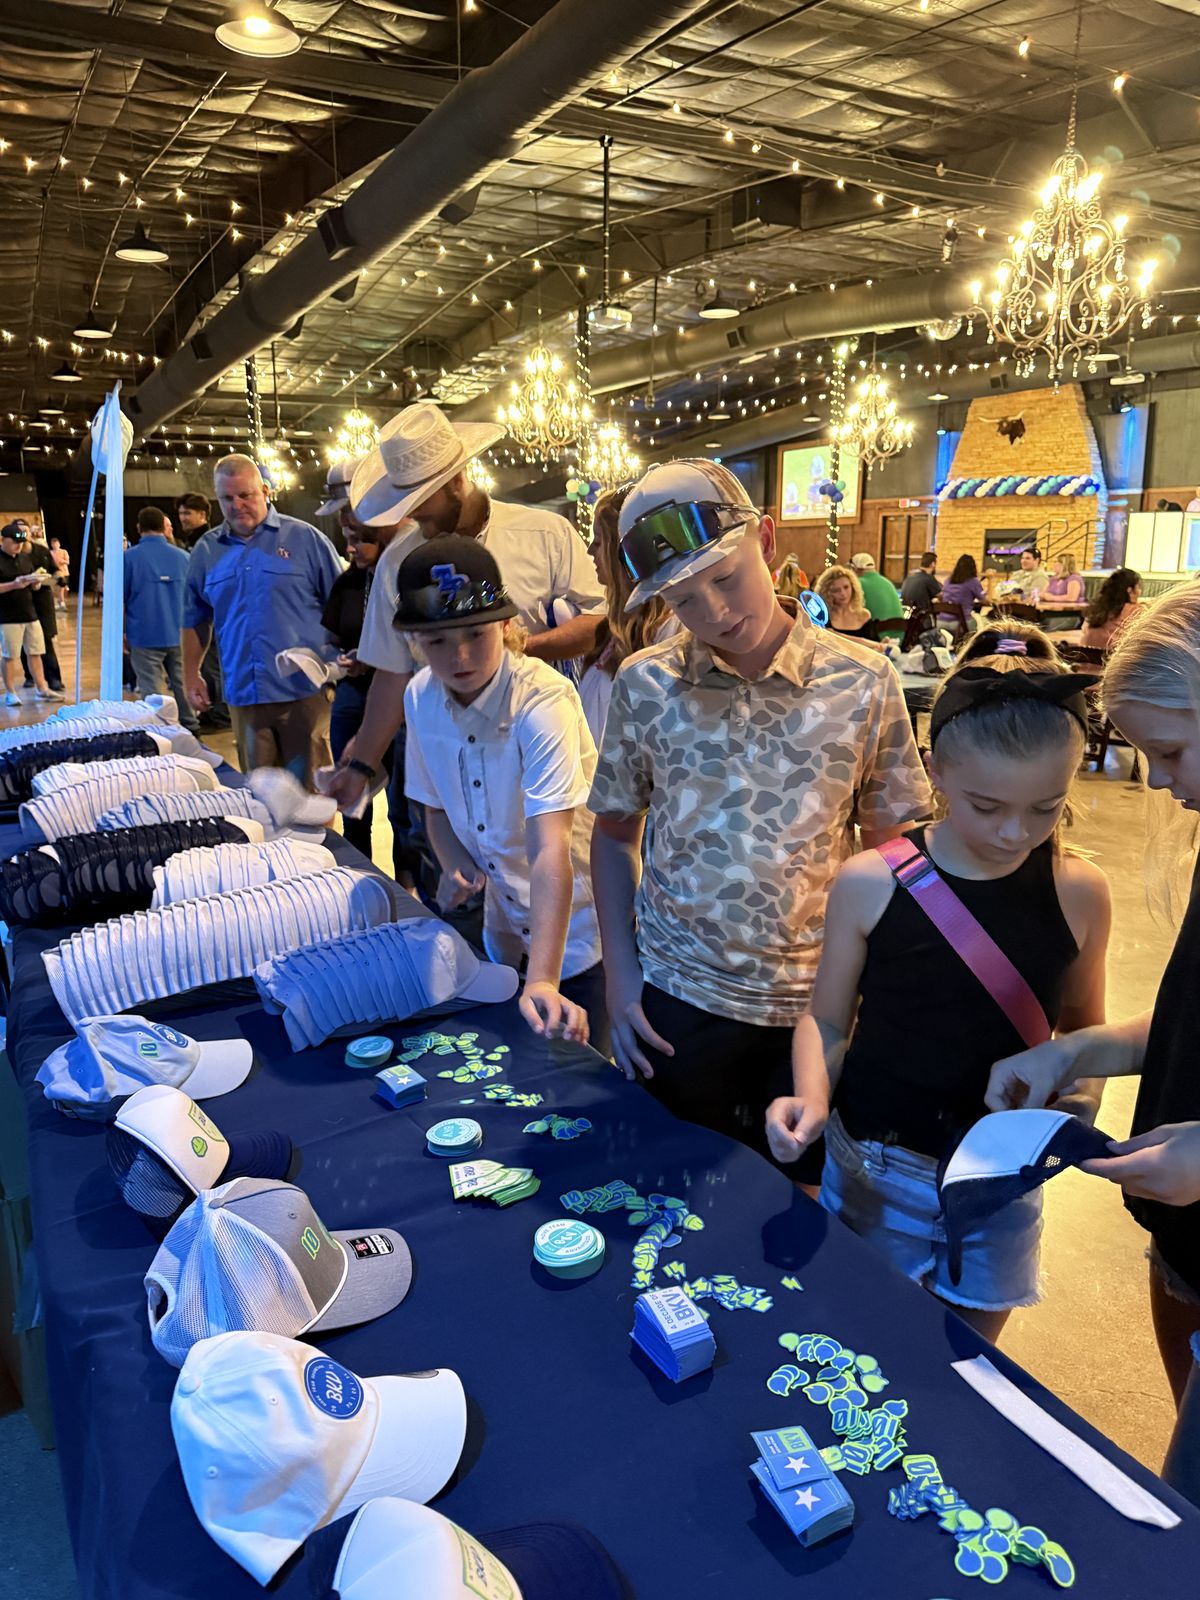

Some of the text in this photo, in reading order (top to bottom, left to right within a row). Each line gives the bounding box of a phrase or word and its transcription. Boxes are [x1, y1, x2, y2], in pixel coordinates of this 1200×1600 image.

[140, 1042, 159, 1057] 10
[301, 1227, 320, 1260] 10
[649, 1293, 659, 1301] OF
[662, 1293, 695, 1321] BKV
[654, 1300, 674, 1325] DECADE
[325, 1370, 343, 1404] BKV
[872, 1415, 898, 1439] 10
[783, 1432, 805, 1450] BKV
